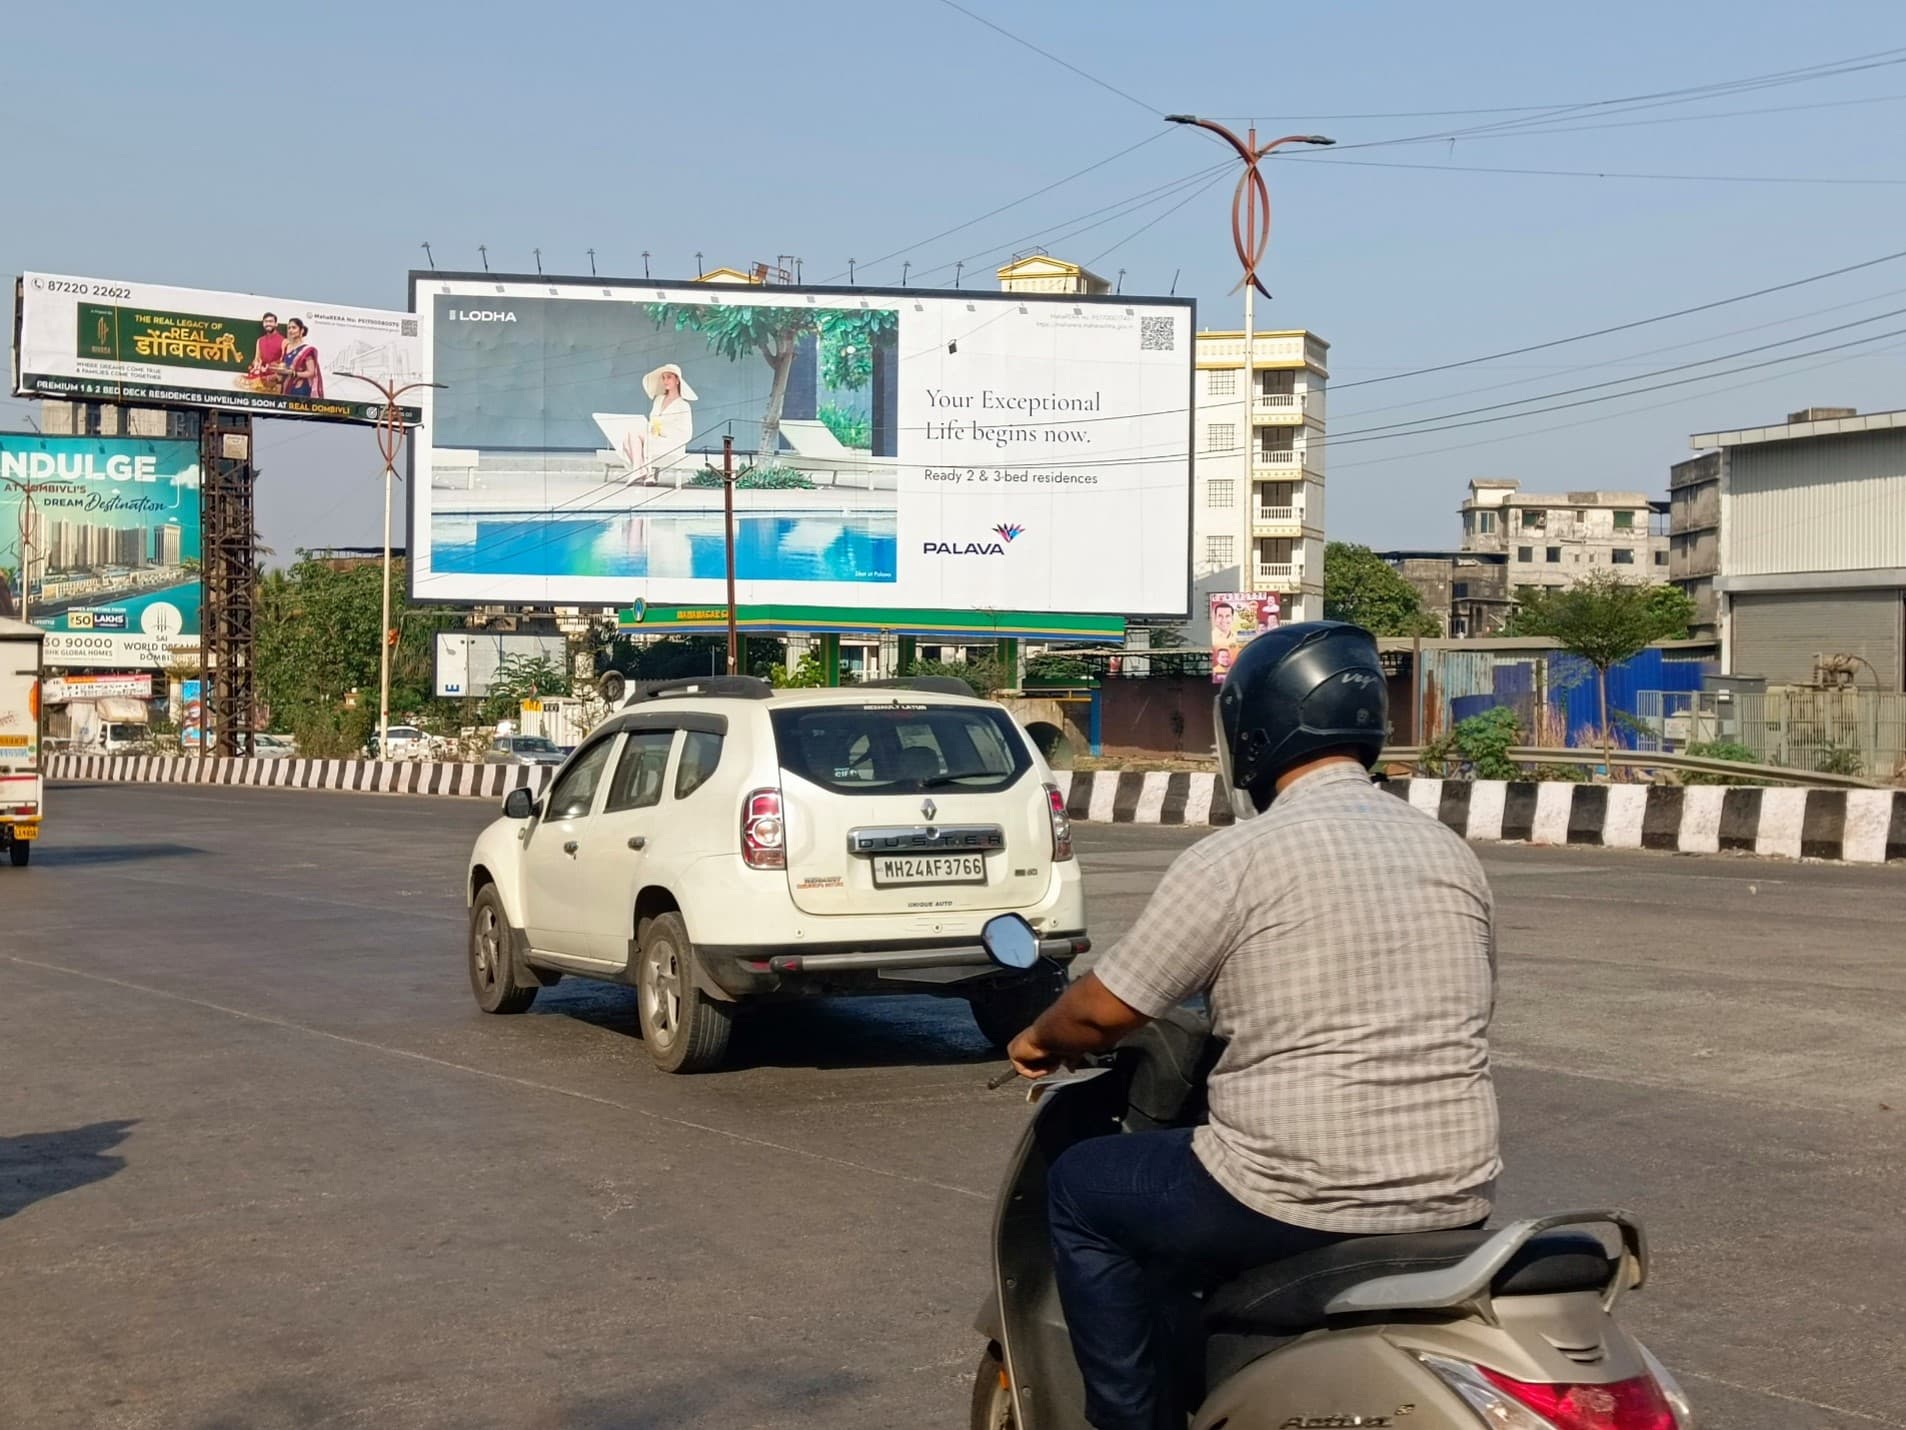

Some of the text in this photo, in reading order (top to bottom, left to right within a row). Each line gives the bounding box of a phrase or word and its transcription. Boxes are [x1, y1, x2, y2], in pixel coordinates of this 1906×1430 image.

[48, 280, 131, 299] 87220 22622
[135, 314, 223, 331] THE REAL LEGACY OF
[459, 310, 517, 322] LODHA
[171, 327, 208, 343] REAL
[36, 380, 78, 392] PREMIUM
[80, 384, 85, 392] 1
[103, 386, 120, 395] BED
[123, 388, 146, 397] DECK
[148, 390, 201, 402] RESIDENCES
[204, 393, 249, 406] UNVEILING
[251, 397, 276, 408] SOON
[277, 401, 287, 409] AT
[311, 404, 350, 415] DOMBIVLI
[926, 389, 1101, 416] Your Exceptional
[926, 420, 1092, 448] Life begins now.
[924, 469, 962, 484] Ready
[966, 470, 975, 482] 2
[979, 470, 989, 482] &
[1032, 471, 1098, 484] residences
[23, 484, 86, 494] OMBIVLI'S
[44, 492, 166, 512] DREAM Destination
[923, 542, 1005, 555] PALAVA
[94, 615, 124, 624] LAKHS
[66, 638, 113, 649] 90000
[124, 642, 158, 651] WORLD
[859, 835, 1001, 849] DUSTER
[885, 858, 981, 878] MH24AF3766
